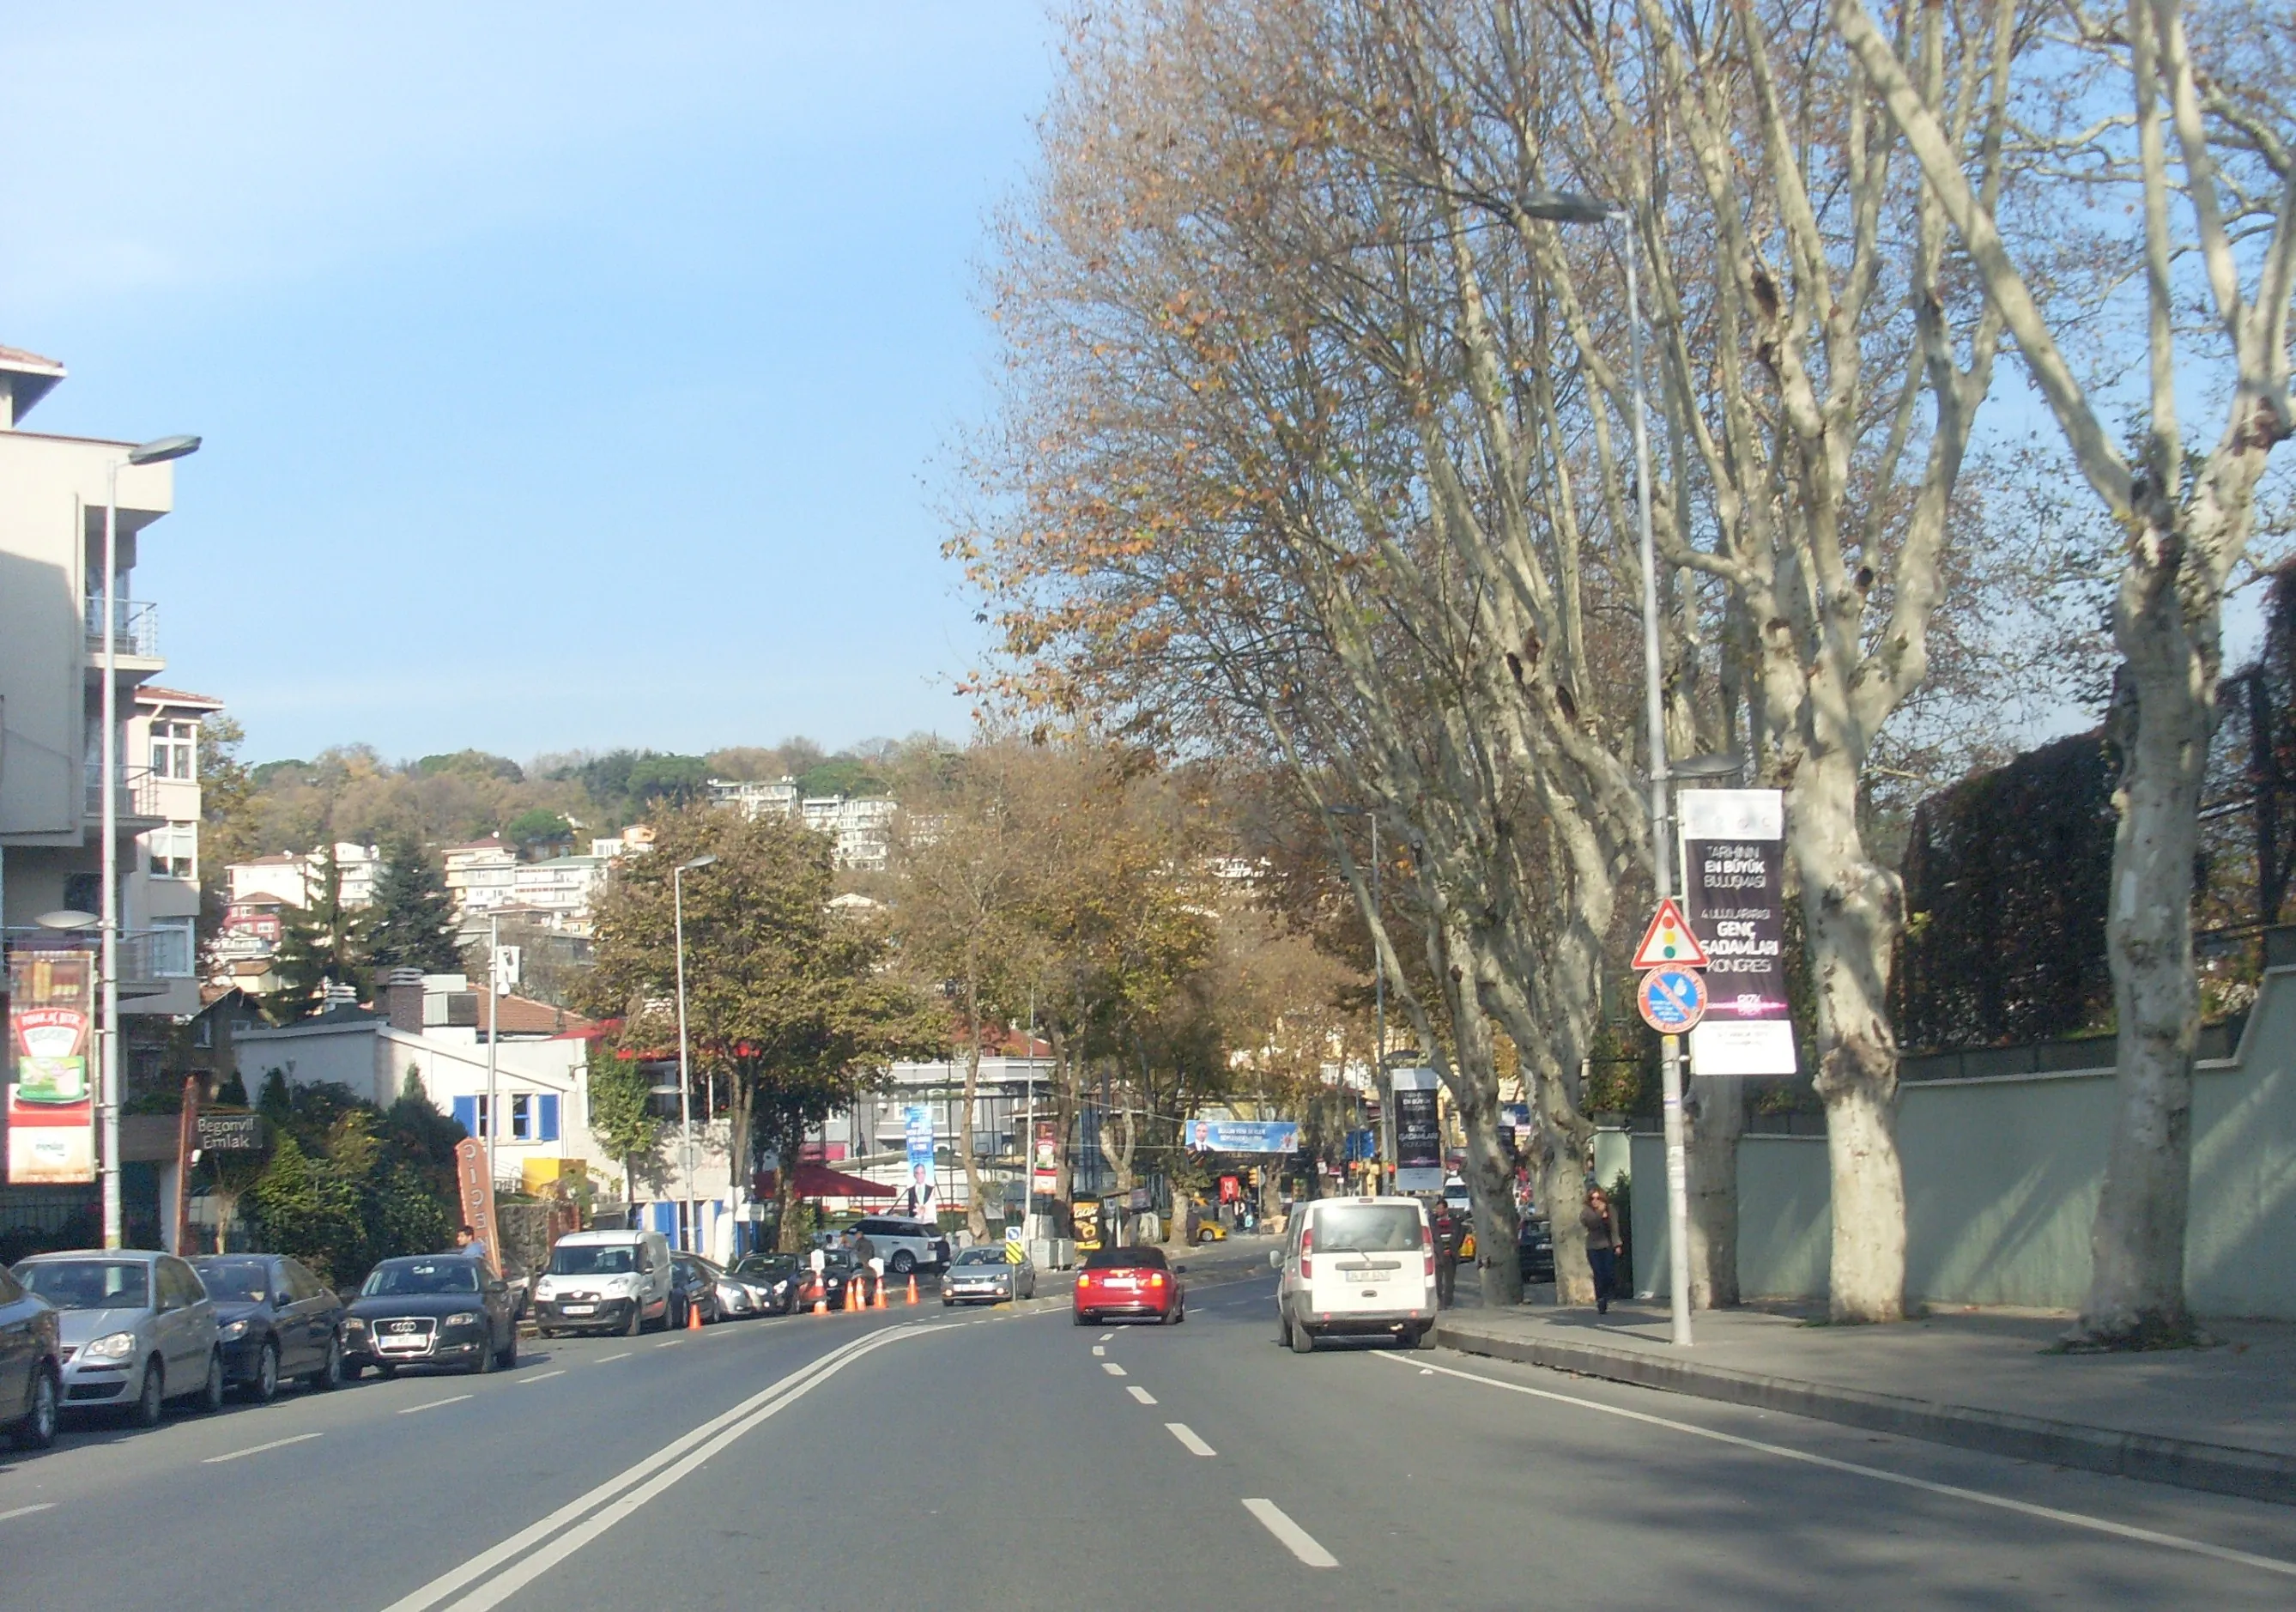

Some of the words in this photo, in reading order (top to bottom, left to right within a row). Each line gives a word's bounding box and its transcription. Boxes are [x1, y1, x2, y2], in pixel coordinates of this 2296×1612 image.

[1704, 859, 1722, 874] EN
[1724, 858, 1766, 874] BÜYÜK
[1717, 921, 1756, 940] GENÇ
[197, 1118, 254, 1136] Begonvil
[203, 1134, 251, 1149] Emlak
